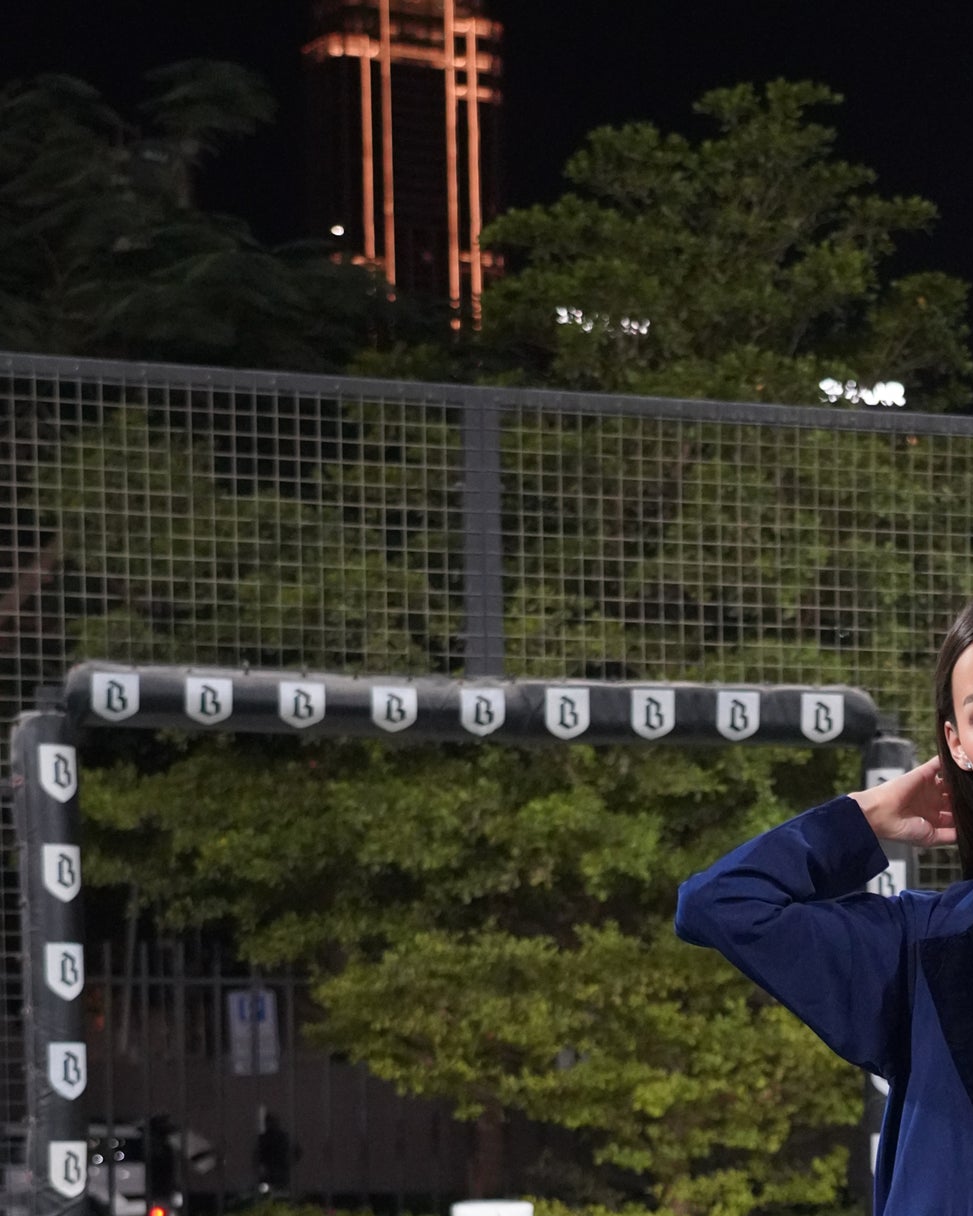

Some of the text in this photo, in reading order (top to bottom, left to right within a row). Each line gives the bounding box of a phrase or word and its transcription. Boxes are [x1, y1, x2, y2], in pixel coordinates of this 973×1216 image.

[105, 680, 128, 713] B
[200, 684, 222, 716] B
[293, 689, 315, 720] B
[385, 693, 407, 723] B
[472, 696, 494, 727] B
[558, 696, 578, 730] B
[644, 697, 664, 732] B
[728, 699, 748, 734] B
[813, 702, 833, 735] B
[53, 753, 72, 788] B
[57, 854, 75, 888] B
[60, 952, 79, 986] B
[63, 1051, 81, 1086] B
[64, 1151, 81, 1185] B
